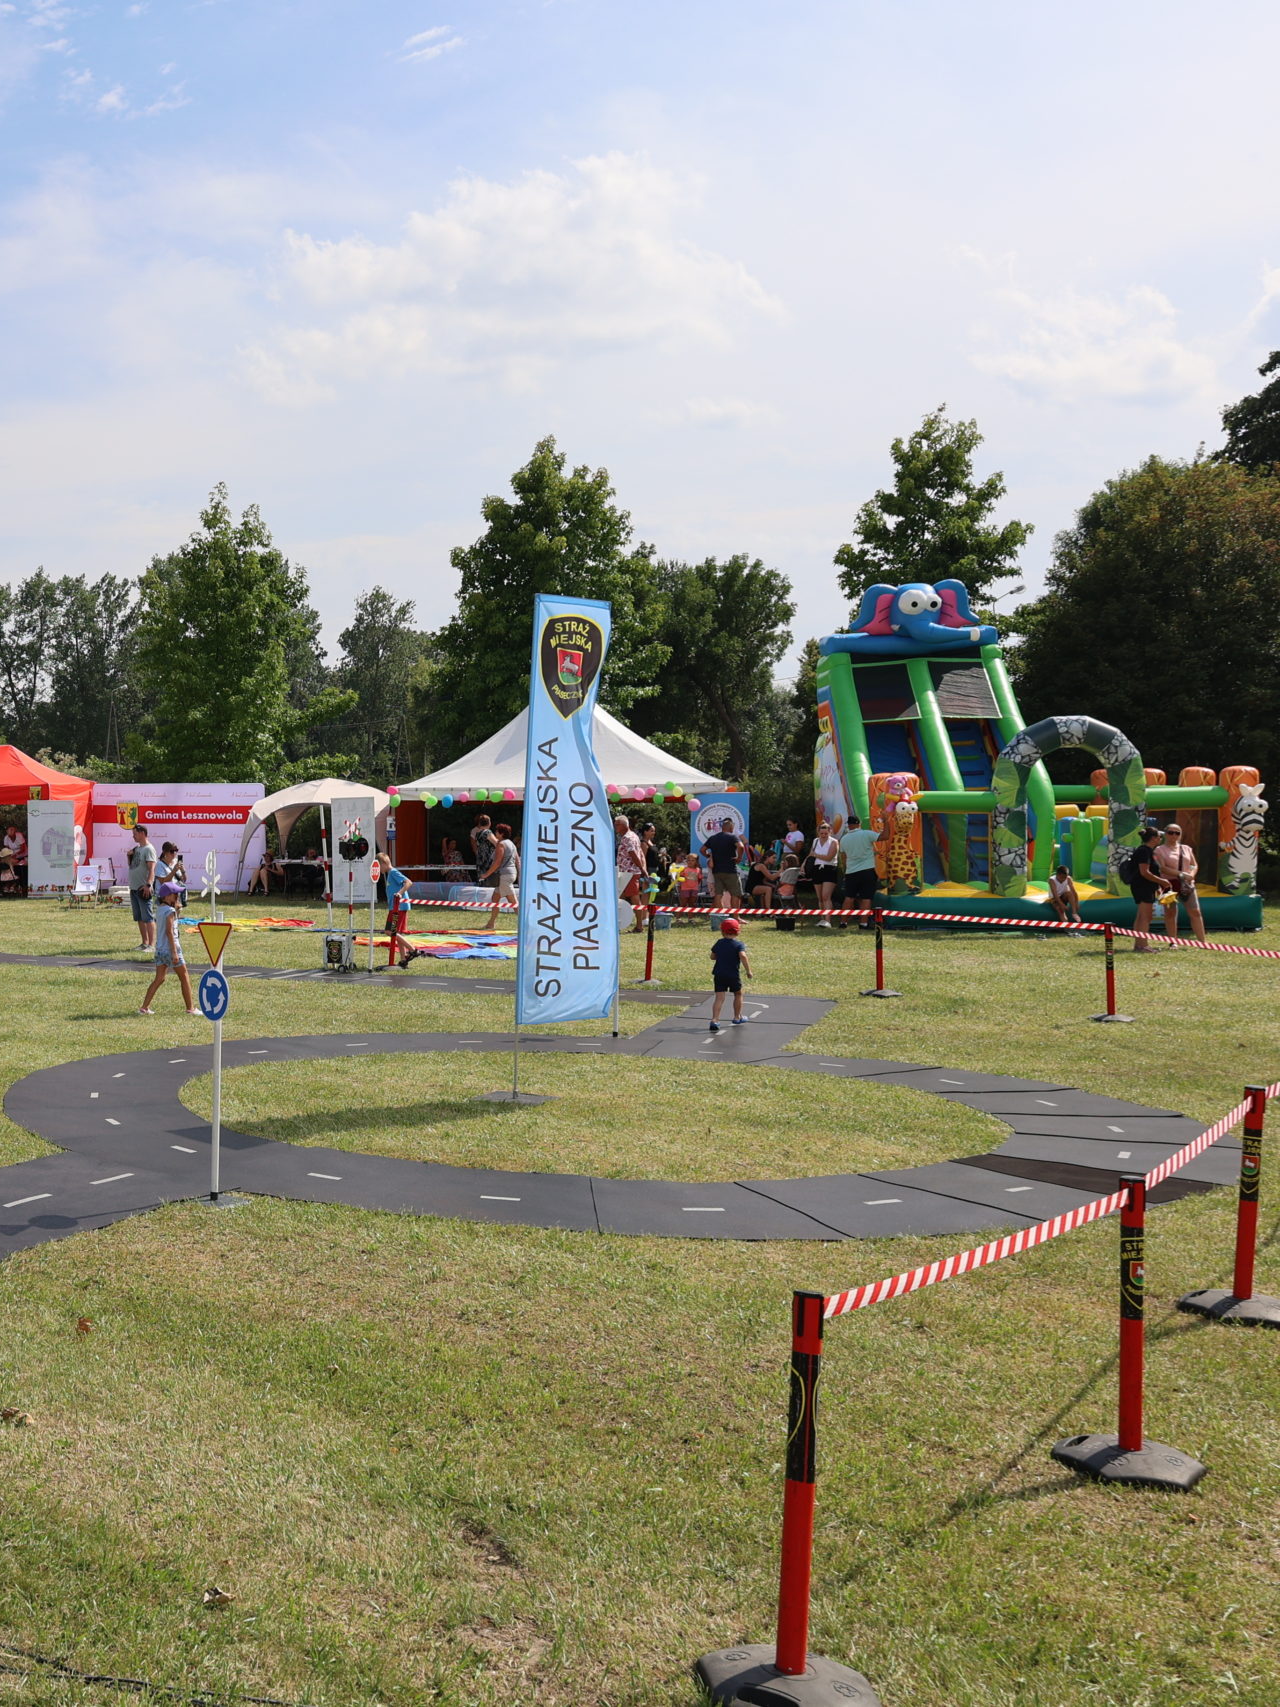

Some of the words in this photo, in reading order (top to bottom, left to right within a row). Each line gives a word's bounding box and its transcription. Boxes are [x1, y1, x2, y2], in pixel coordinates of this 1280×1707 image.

[550, 634, 593, 653] MIEJSKA
[554, 621, 590, 637] STRAŻ
[145, 810, 179, 820] Gmina
[181, 810, 243, 820] Lesznowola
[537, 737, 559, 883] MIEJSKA
[569, 782, 601, 970] PIASECZNO
[532, 892, 562, 998] STRAŻ
